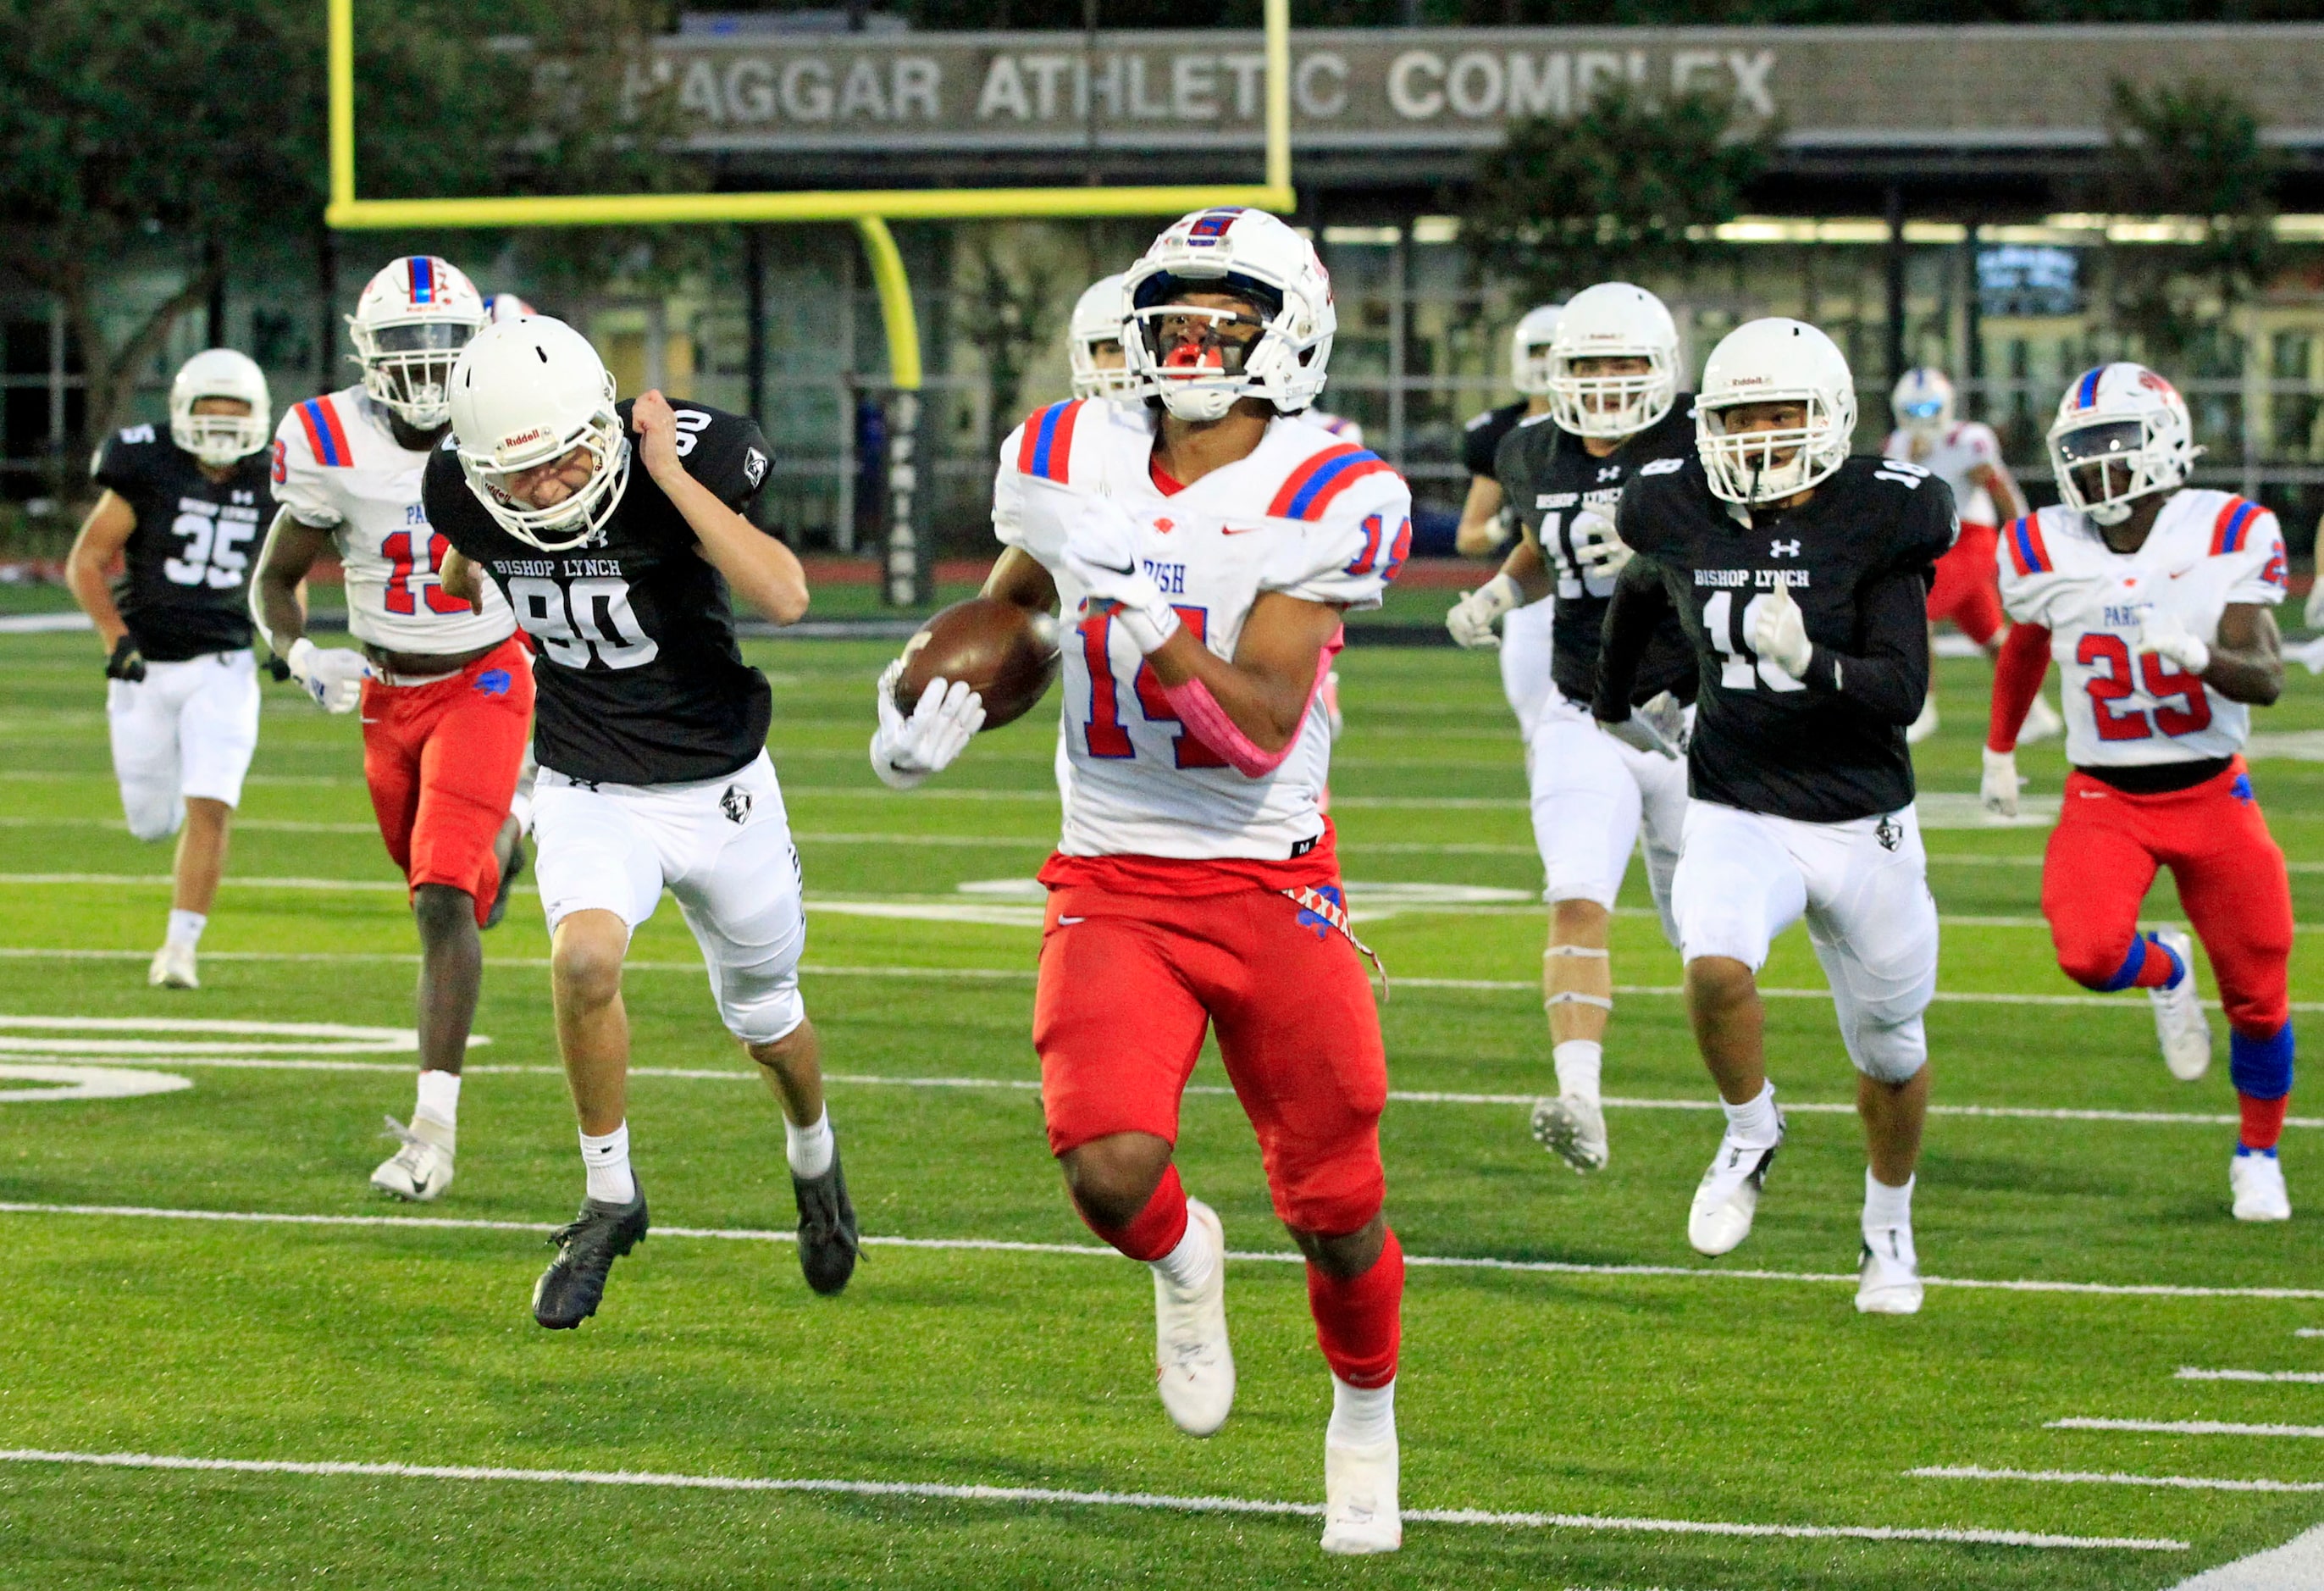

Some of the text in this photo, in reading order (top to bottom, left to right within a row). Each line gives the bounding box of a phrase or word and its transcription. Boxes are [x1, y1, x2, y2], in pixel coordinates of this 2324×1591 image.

[977, 53, 1349, 120] ATHLETC
[505, 429, 540, 448] Riddell
[164, 513, 257, 590] 35
[493, 559, 622, 577] BISHOP LYNCH
[1694, 568, 1811, 588] BISHOP LYNCH
